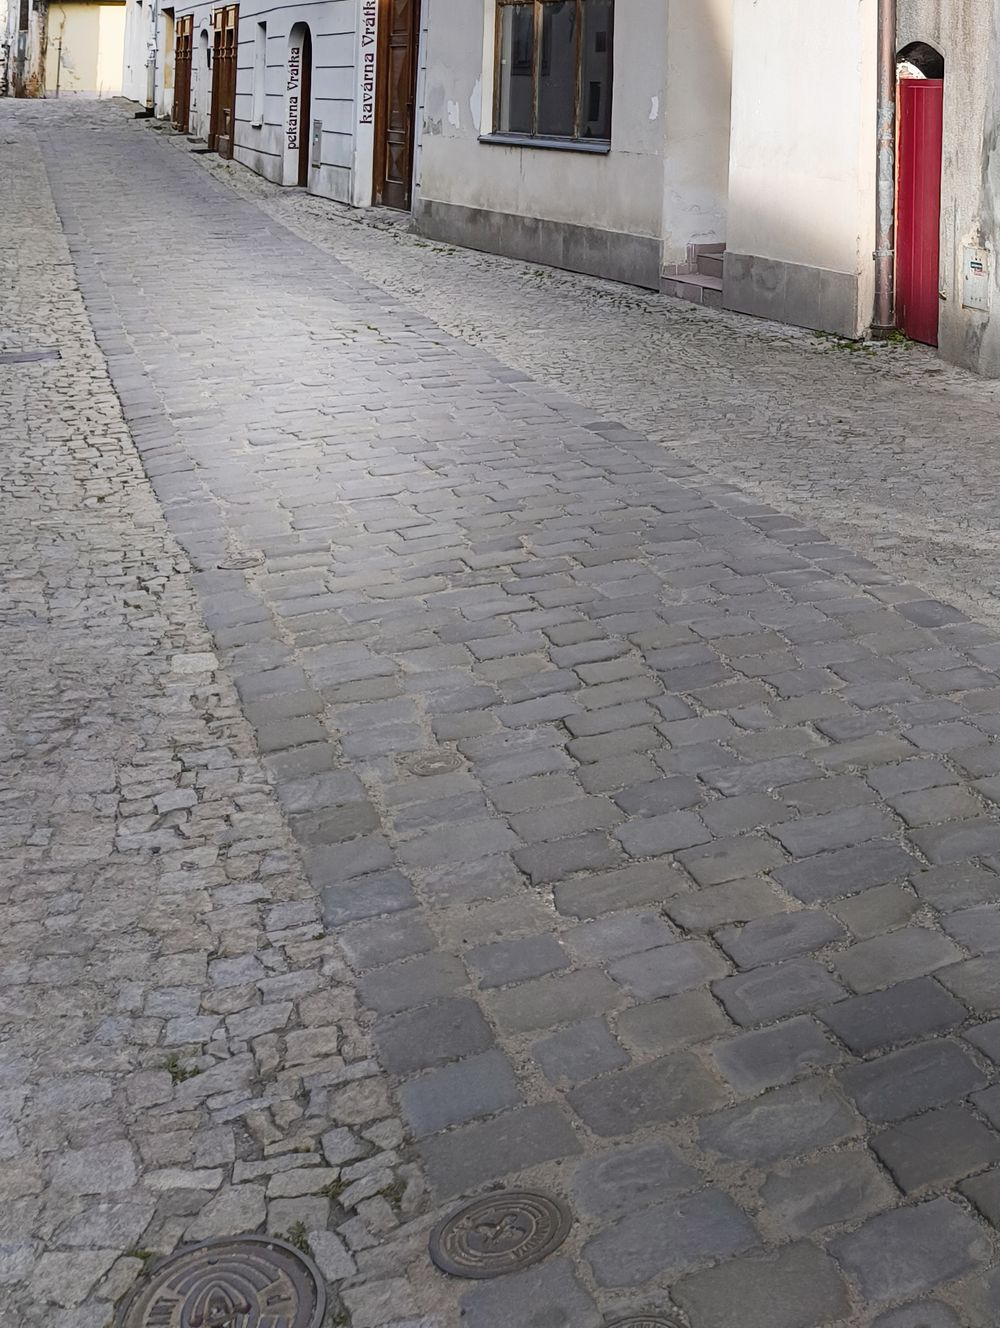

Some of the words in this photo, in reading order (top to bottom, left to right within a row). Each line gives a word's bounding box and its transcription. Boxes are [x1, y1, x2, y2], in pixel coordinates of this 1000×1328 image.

[287, 47, 300, 91] Vrátka
[360, 53, 375, 125] kavárna
[286, 96, 299, 150] pekárna
